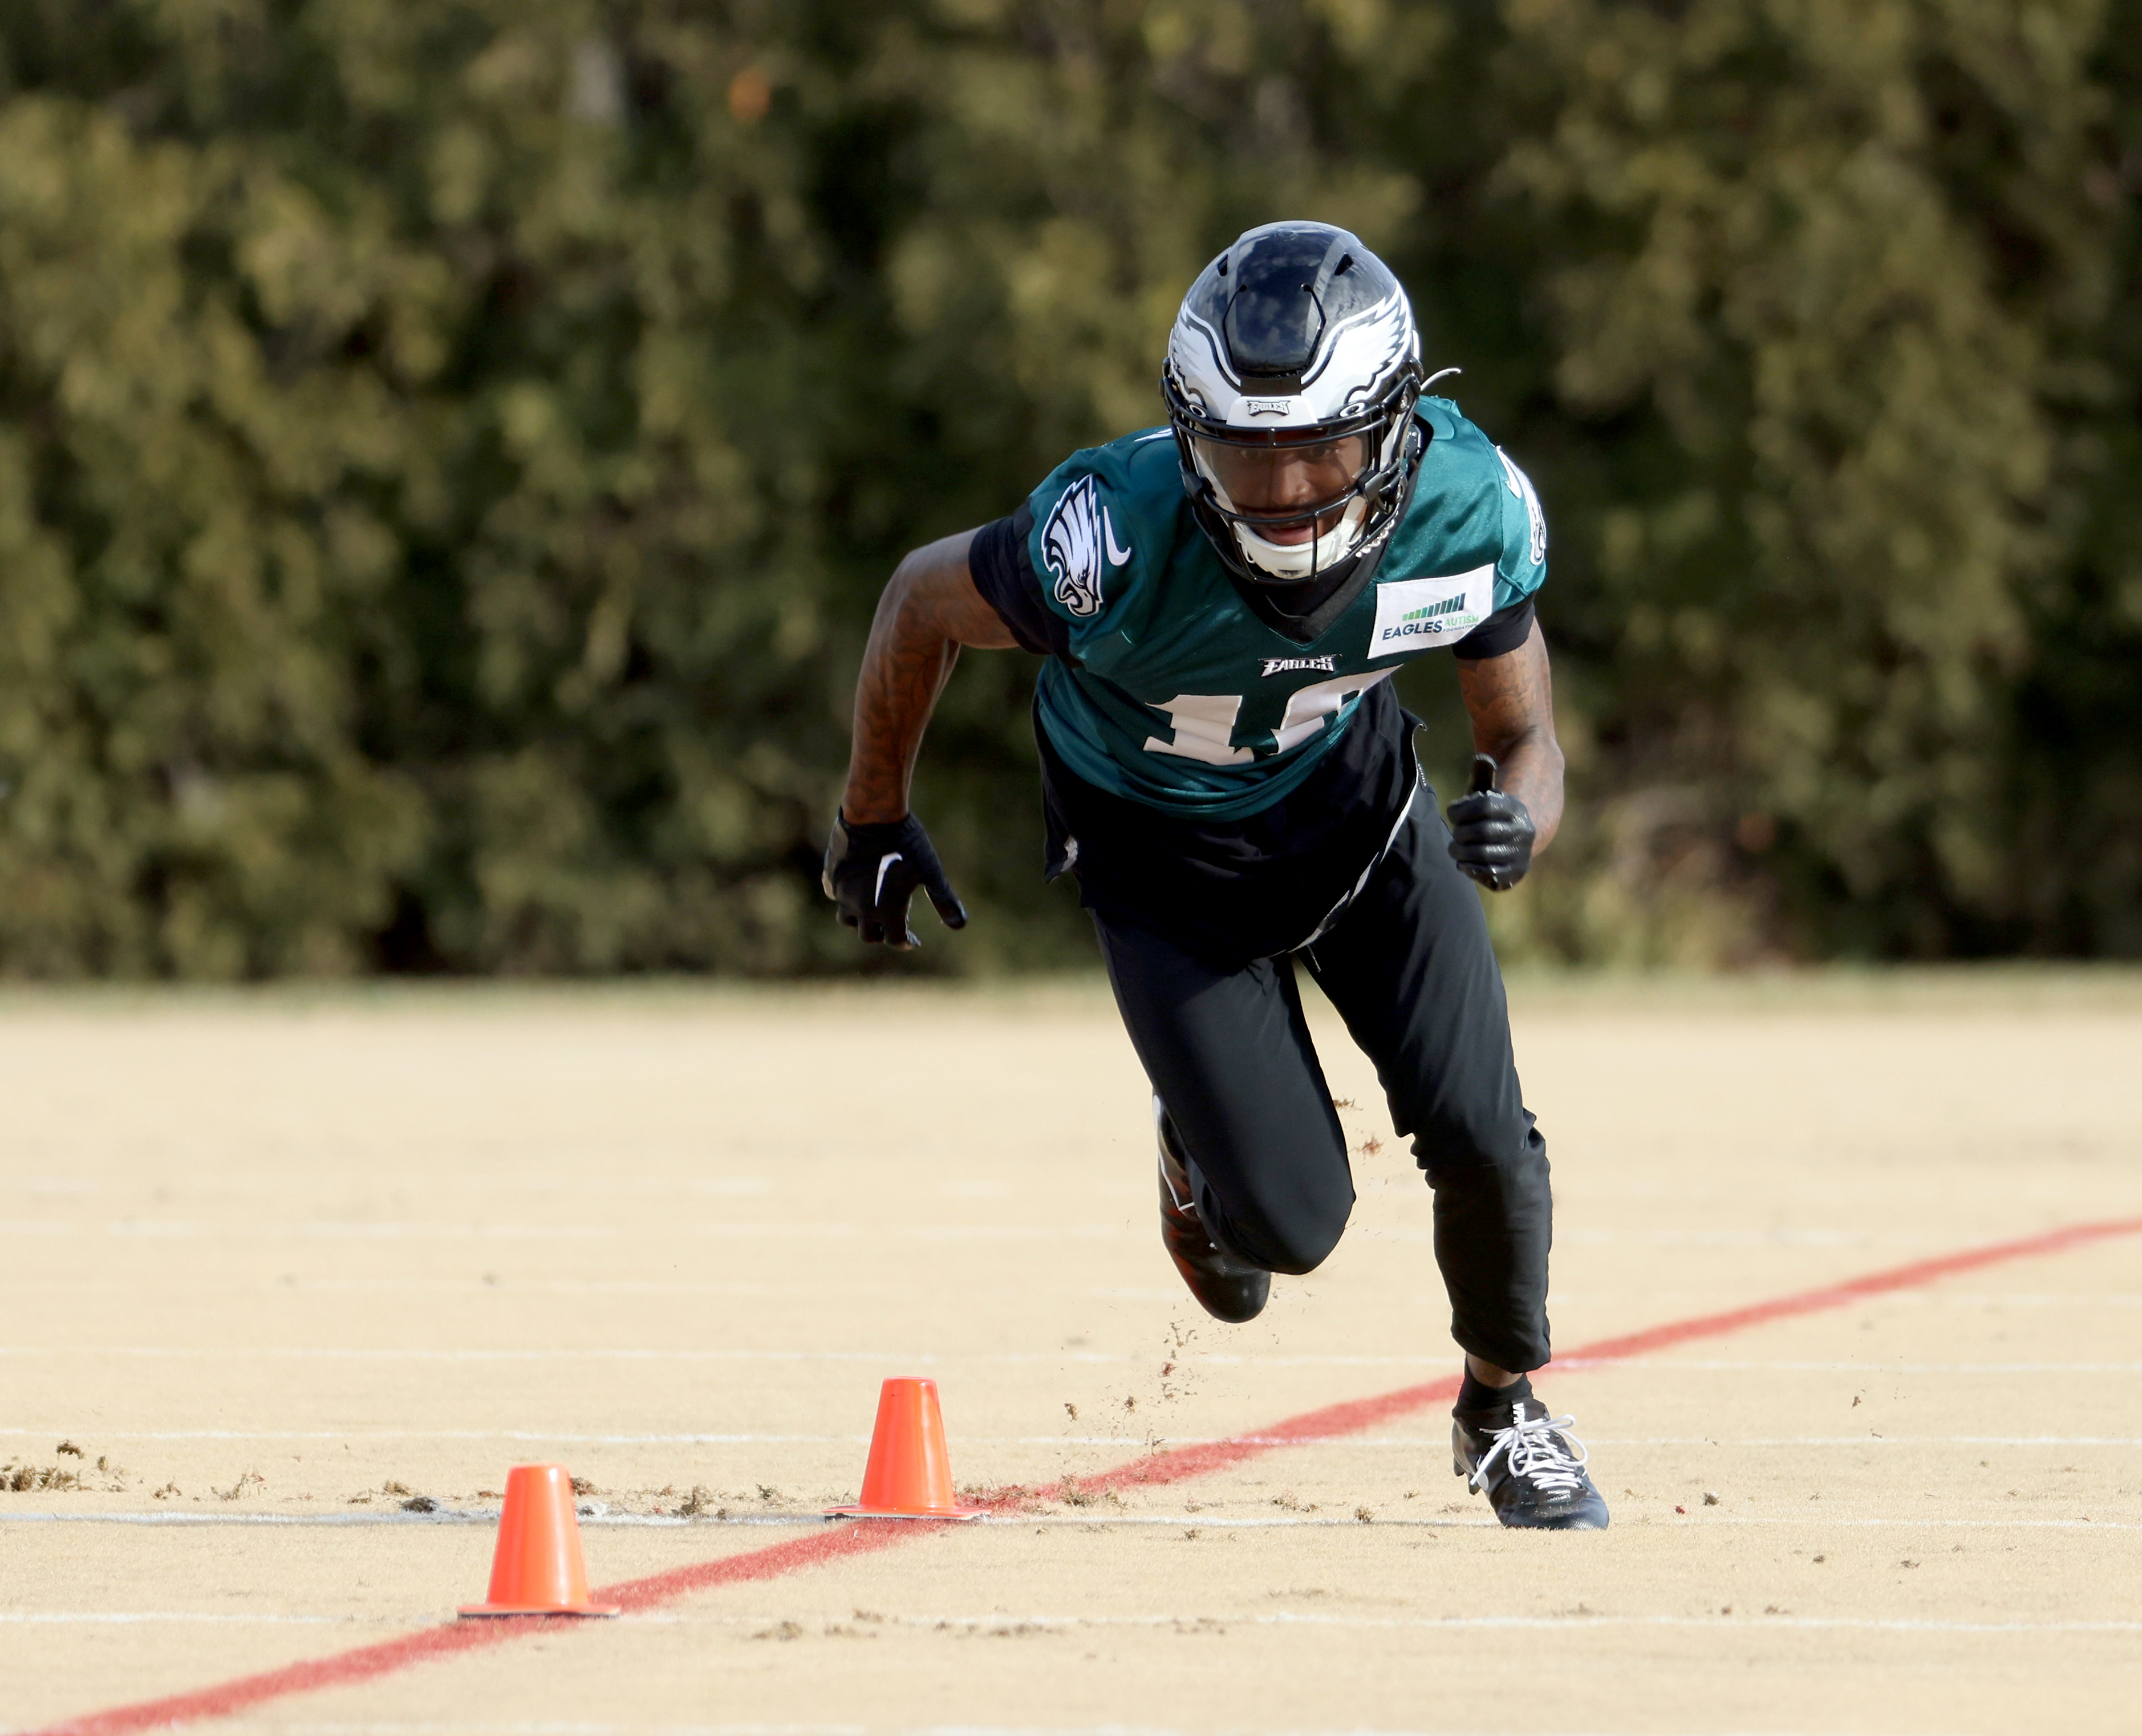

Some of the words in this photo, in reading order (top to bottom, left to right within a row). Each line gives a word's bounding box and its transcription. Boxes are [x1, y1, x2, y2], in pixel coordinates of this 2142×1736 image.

[1247, 400, 1290, 416] EAGLES
[1382, 619, 1443, 640] EAGLES
[1445, 614, 1479, 627] AUTISM
[1260, 656, 1336, 678] EAGLES
